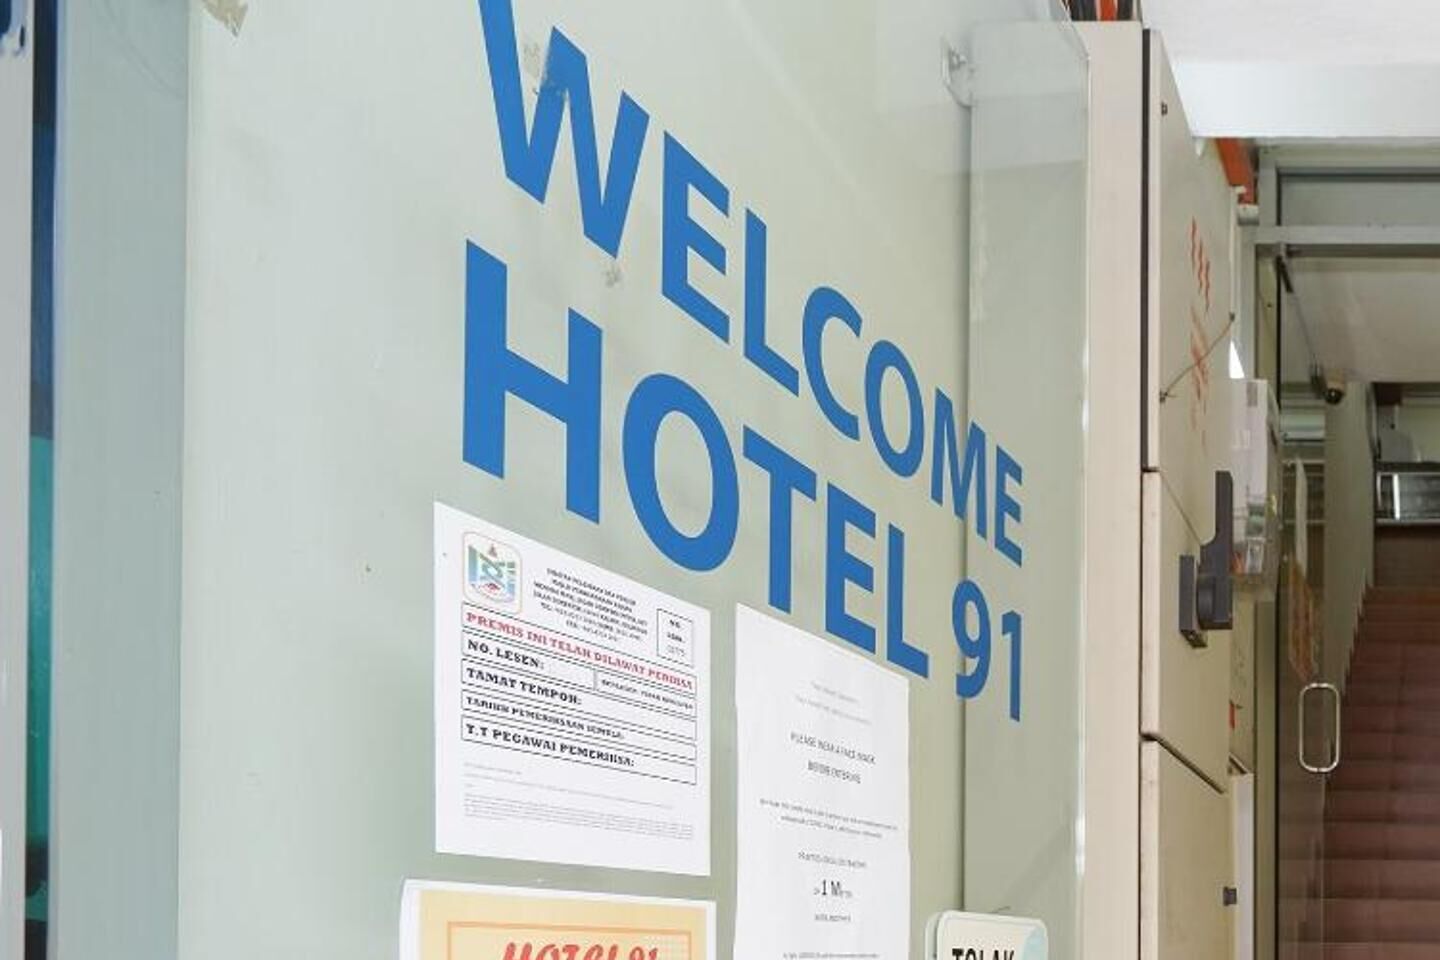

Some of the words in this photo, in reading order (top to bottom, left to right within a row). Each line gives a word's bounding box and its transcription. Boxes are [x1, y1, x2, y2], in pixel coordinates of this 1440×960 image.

[478, 0, 1023, 568] WELCOME
[462, 238, 930, 680] HOTEL
[950, 578, 1022, 723] 91
[467, 612, 523, 638] PREMIS
[527, 631, 547, 646] INI
[549, 638, 591, 658] TELAH
[468, 639, 493, 656] NO.
[466, 667, 517, 689] TAMAT
[466, 723, 488, 737] T.T
[492, 729, 557, 751] PEGAWAI
